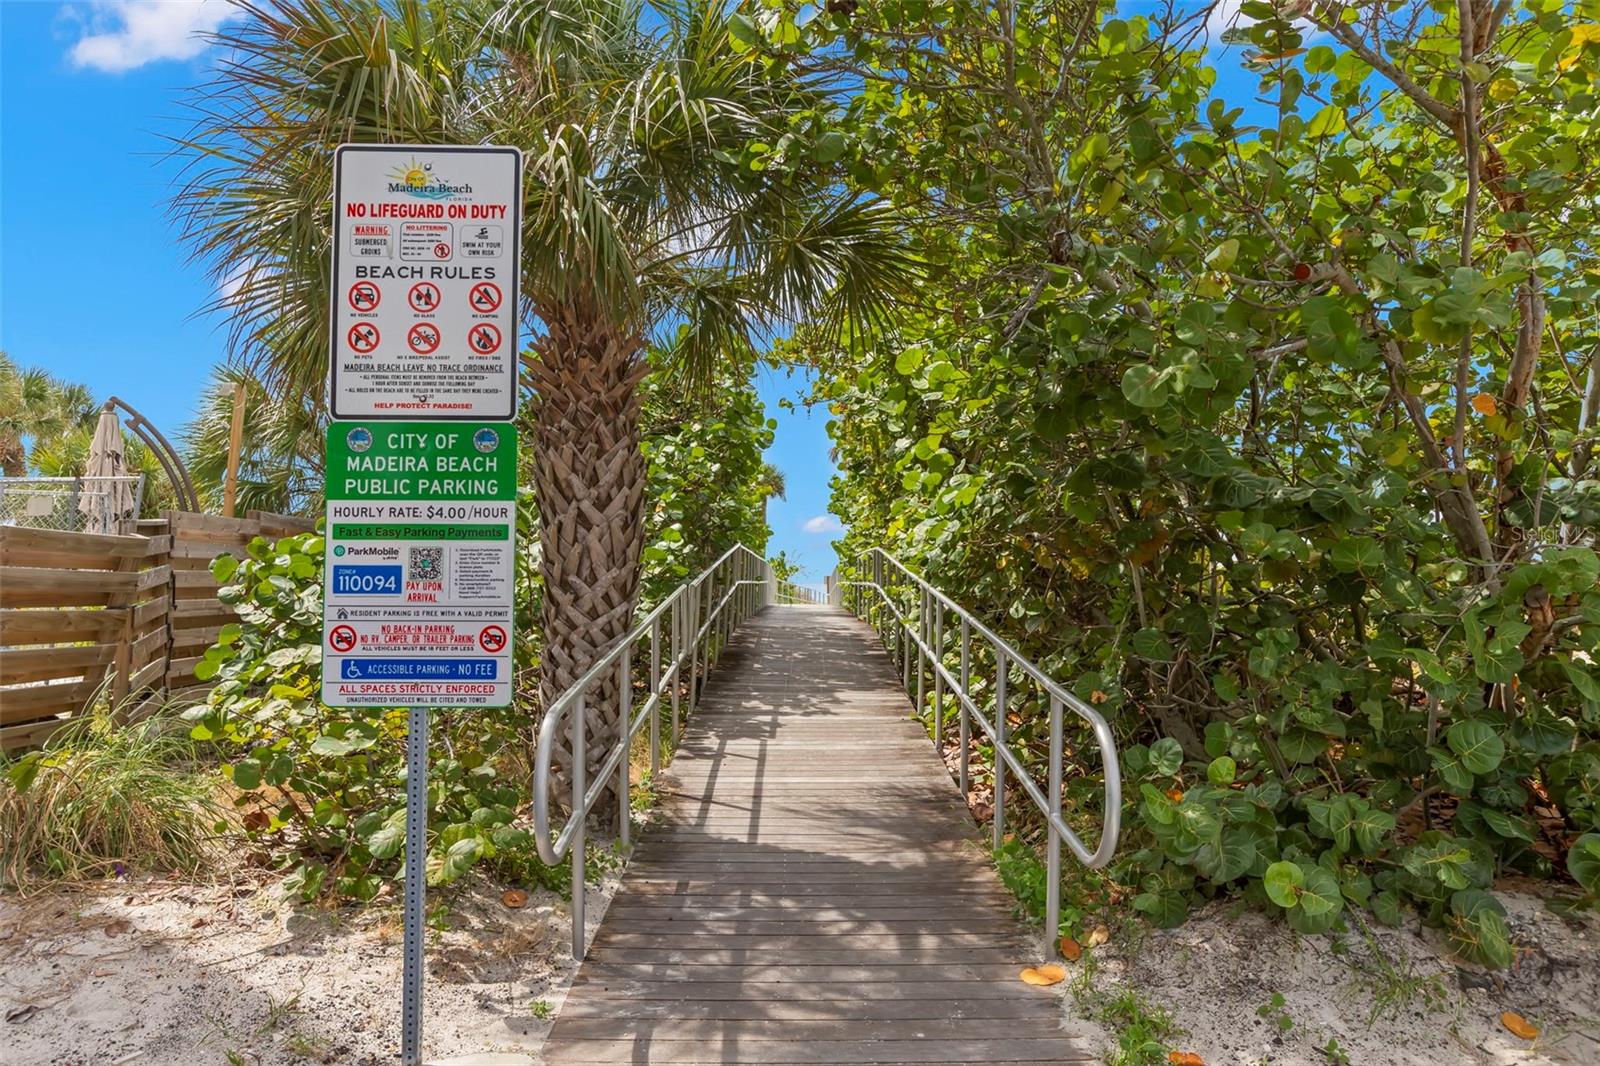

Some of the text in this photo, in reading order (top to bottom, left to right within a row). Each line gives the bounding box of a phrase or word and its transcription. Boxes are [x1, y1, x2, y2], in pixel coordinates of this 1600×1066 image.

[388, 183, 472, 193] Madeira Beach
[347, 203, 506, 219] NO LIFEGUARD ON DUTY
[354, 226, 388, 234] WARNING
[356, 266, 496, 279] BEACH RULES
[388, 434, 428, 449] CITY
[435, 434, 459, 449] OF
[347, 456, 498, 472] MADEIRA BEACH
[345, 479, 498, 494] PUBLIC PARKING
[334, 507, 384, 518] HOURLY
[388, 507, 422, 518] RATE:
[339, 528, 502, 538] Fast & Easy Parking Payments
[348, 547, 399, 555] ParkMobile
[338, 576, 396, 591] 110094
[406, 582, 420, 590] PAY
[408, 593, 438, 602] ARRIVAL
[382, 625, 454, 634] NO BACK-IN PARKING
[361, 635, 368, 644] NO
[412, 635, 420, 644] OR
[424, 635, 446, 644] TRAILER
[450, 635, 474, 644] PARKING
[368, 664, 414, 674] ACCESSIBLE
[416, 664, 450, 674] PARKING
[458, 664, 472, 675] NO
[475, 664, 492, 675] FEE
[400, 685, 442, 693] STRICTLY
[446, 685, 495, 693] ENFORCED
